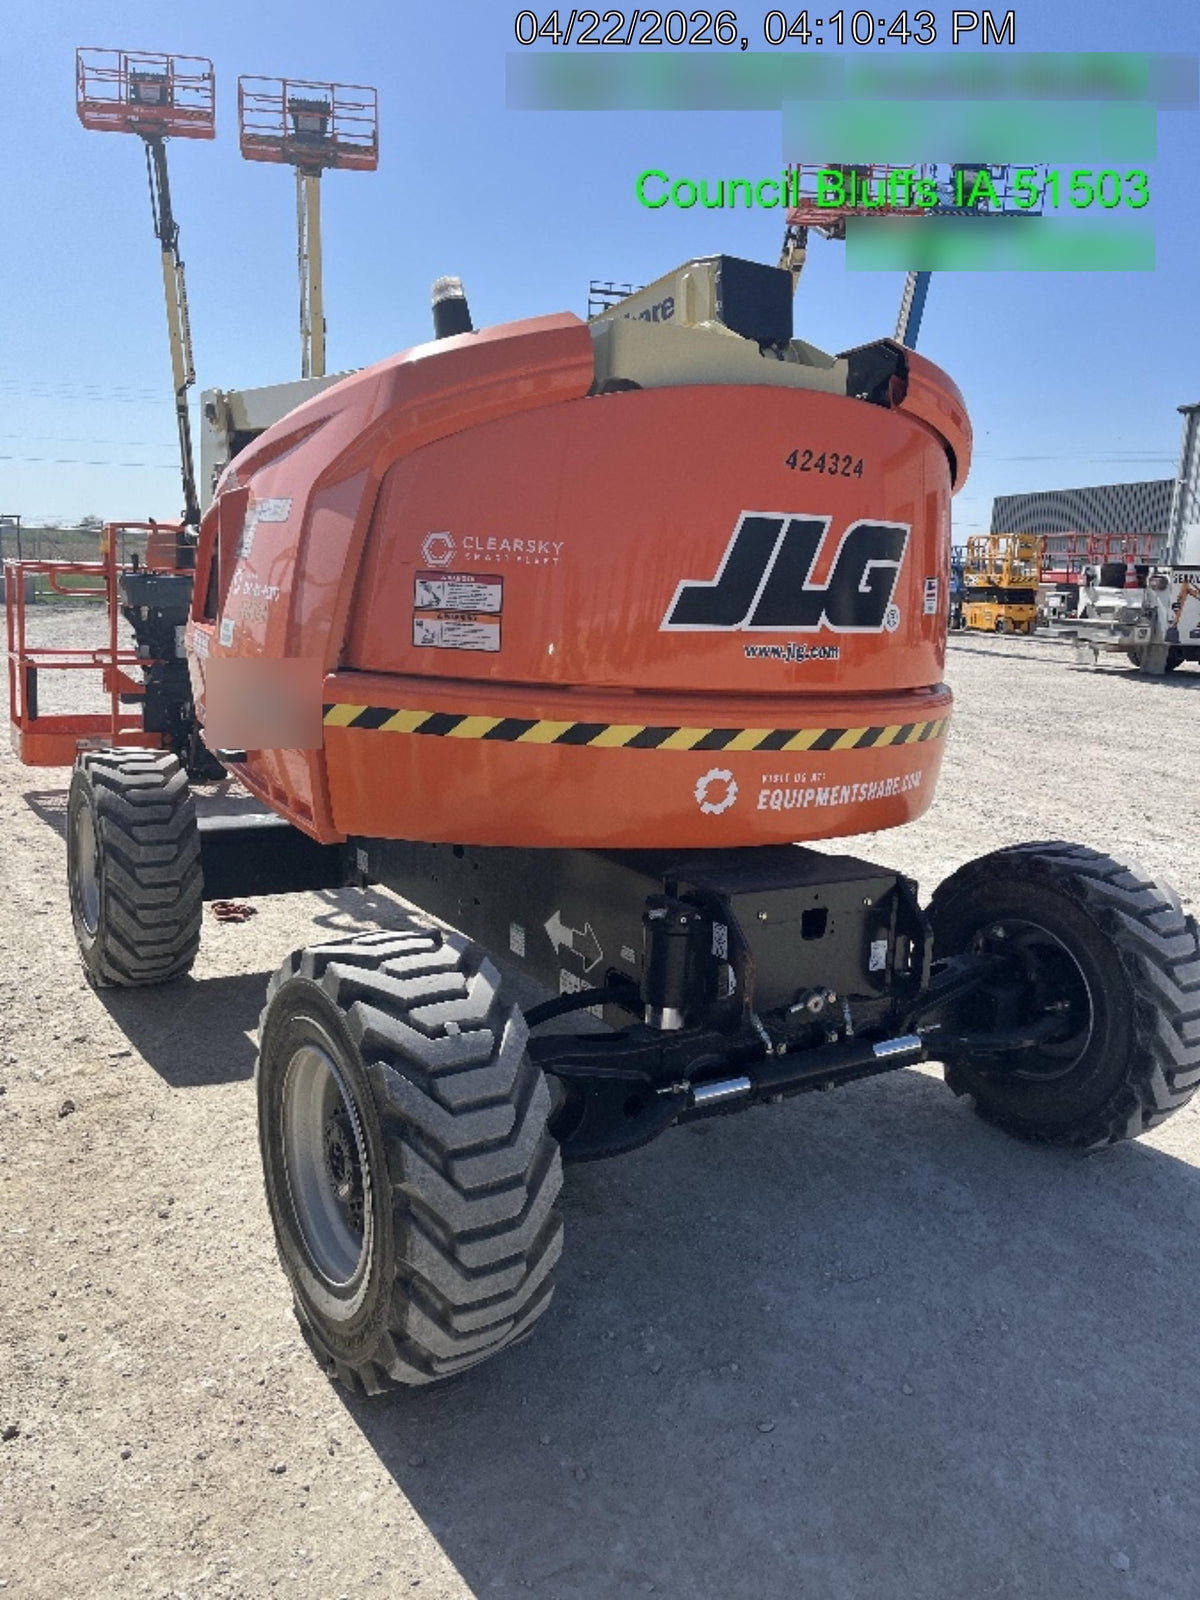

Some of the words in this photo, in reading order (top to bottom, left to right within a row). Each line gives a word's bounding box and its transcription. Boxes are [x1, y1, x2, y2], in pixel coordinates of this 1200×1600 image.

[624, 296, 675, 322] are
[785, 448, 864, 479] 424324
[462, 536, 564, 555] CLEARSKY
[658, 510, 912, 633] JLG
[742, 641, 840, 664] www.jlg.com
[794, 772, 807, 784] US
